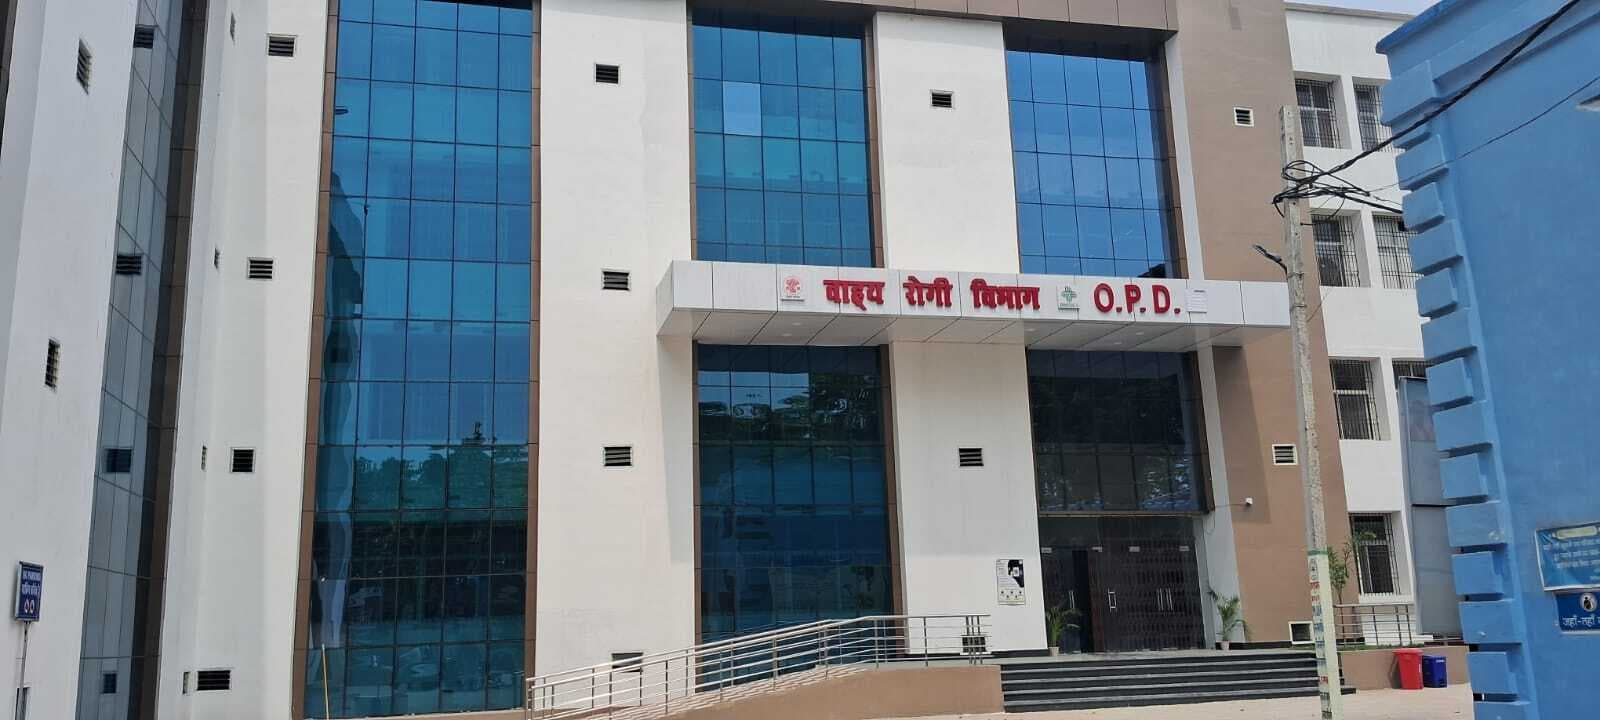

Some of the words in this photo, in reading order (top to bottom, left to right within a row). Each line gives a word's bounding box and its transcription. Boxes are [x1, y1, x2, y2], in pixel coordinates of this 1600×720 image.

[903, 276, 953, 307] रोगी
[970, 278, 1041, 310] विभाग
[1093, 283, 1181, 314] O.P.D.
